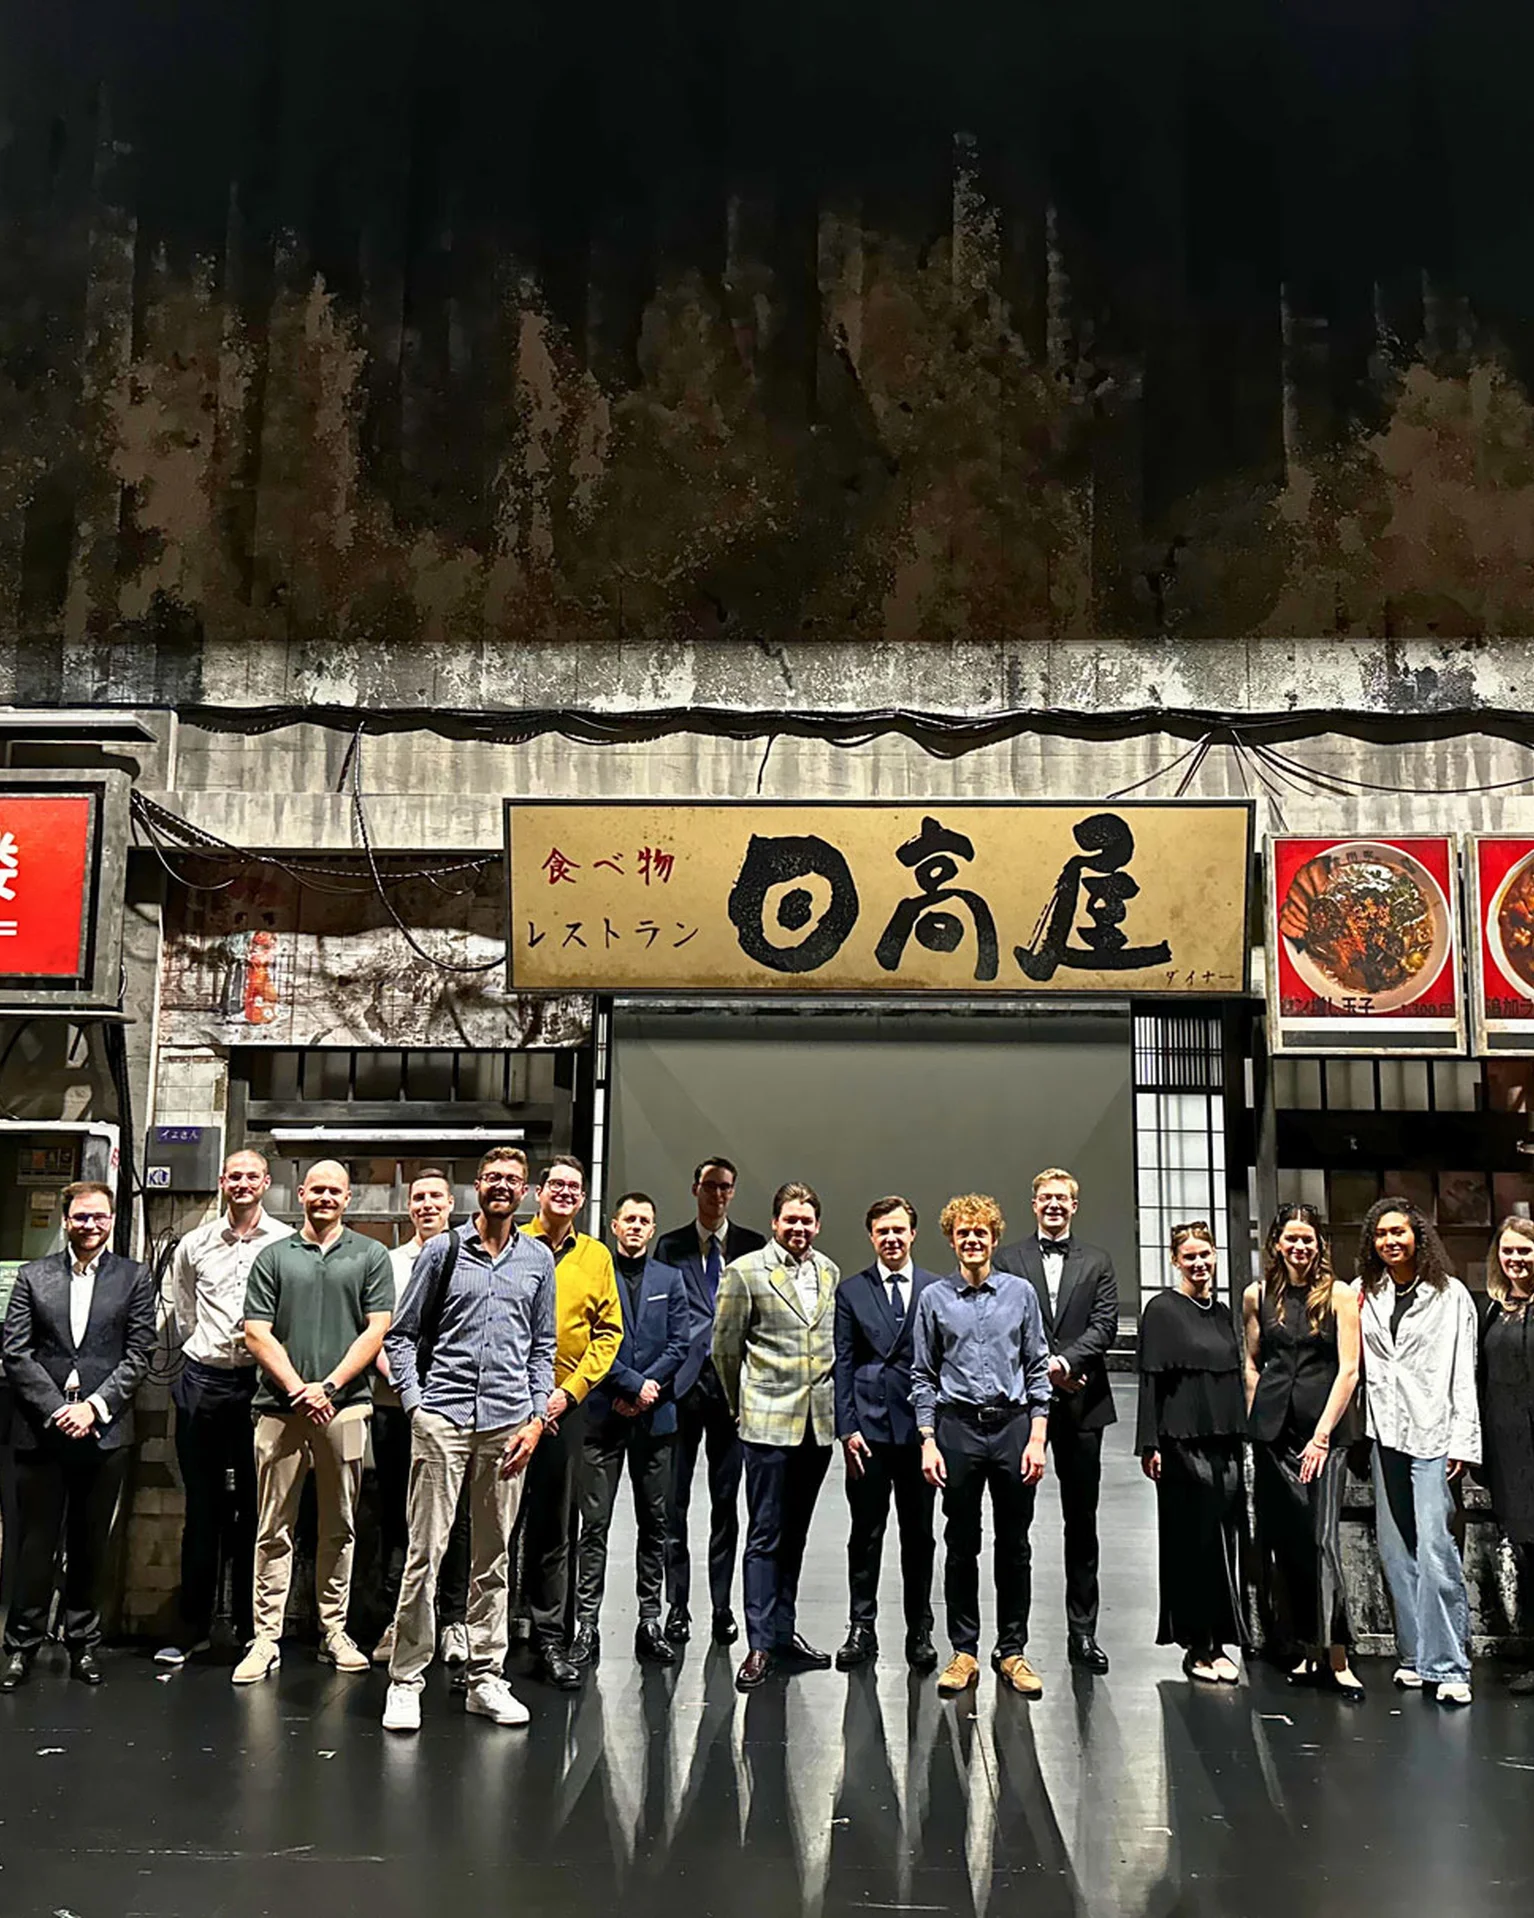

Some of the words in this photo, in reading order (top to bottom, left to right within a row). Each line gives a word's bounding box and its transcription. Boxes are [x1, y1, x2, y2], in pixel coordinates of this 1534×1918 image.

[542, 846, 675, 886] 食べ物
[527, 917, 699, 949] レストラン
[1165, 969, 1235, 986] ダイナー
